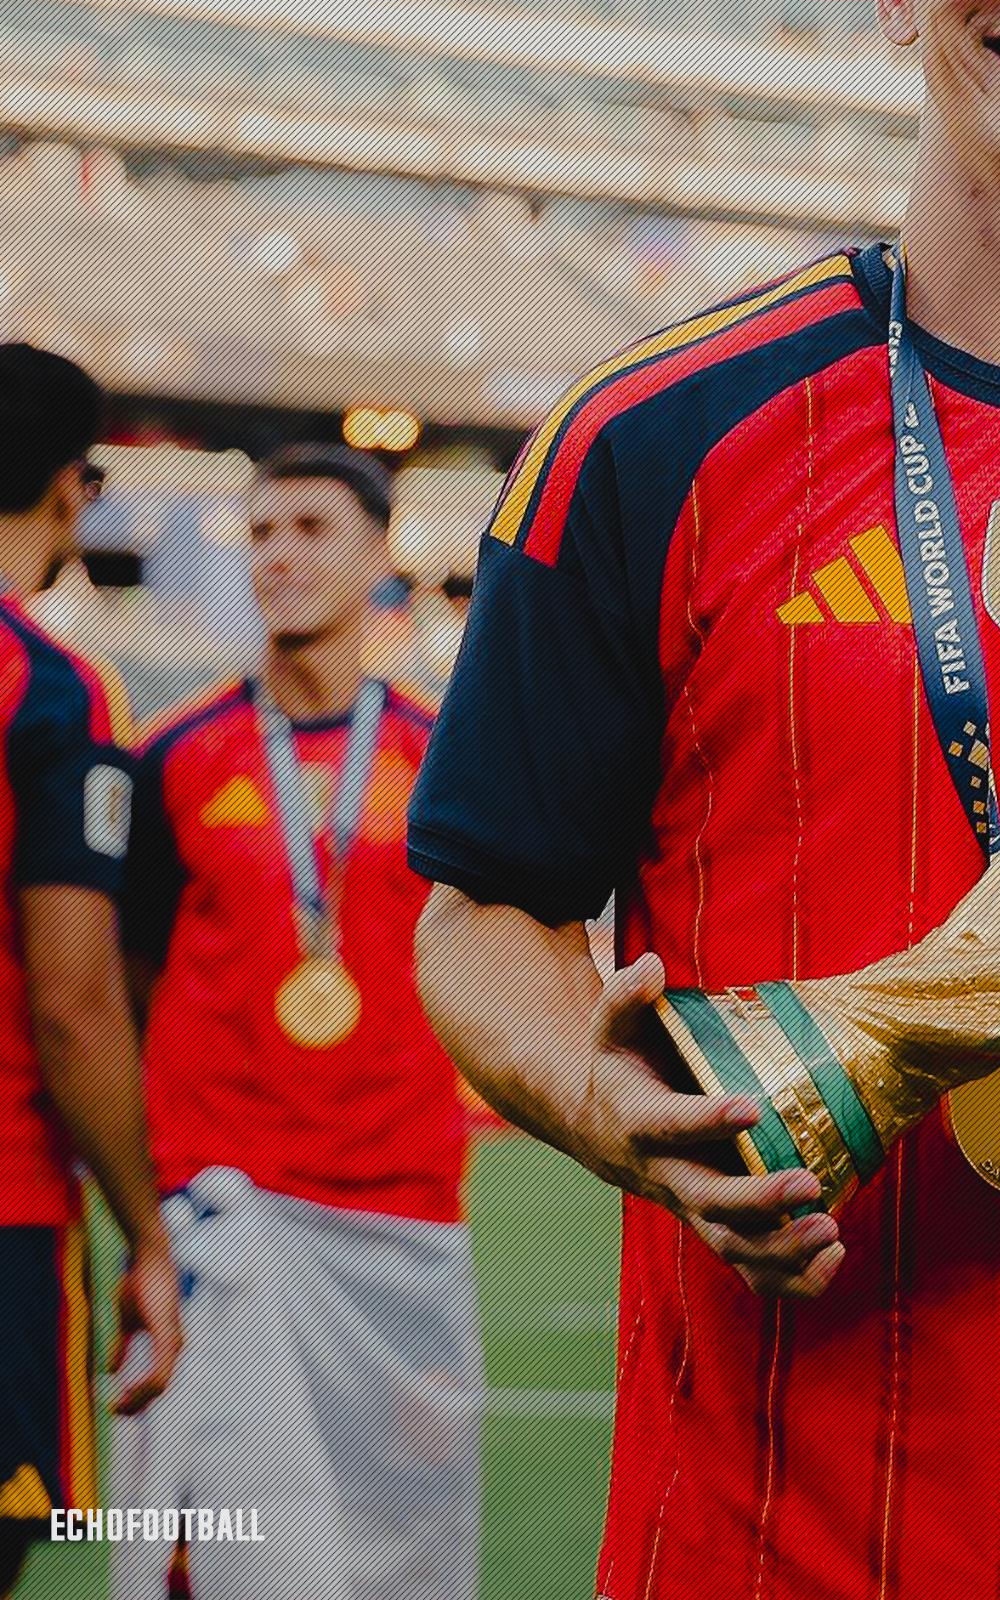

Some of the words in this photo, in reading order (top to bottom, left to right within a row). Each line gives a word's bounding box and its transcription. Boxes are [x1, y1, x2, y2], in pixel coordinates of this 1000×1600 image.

[900, 434, 934, 495] CUP
[914, 500, 954, 618] WORLD
[935, 618, 971, 695] FIFA
